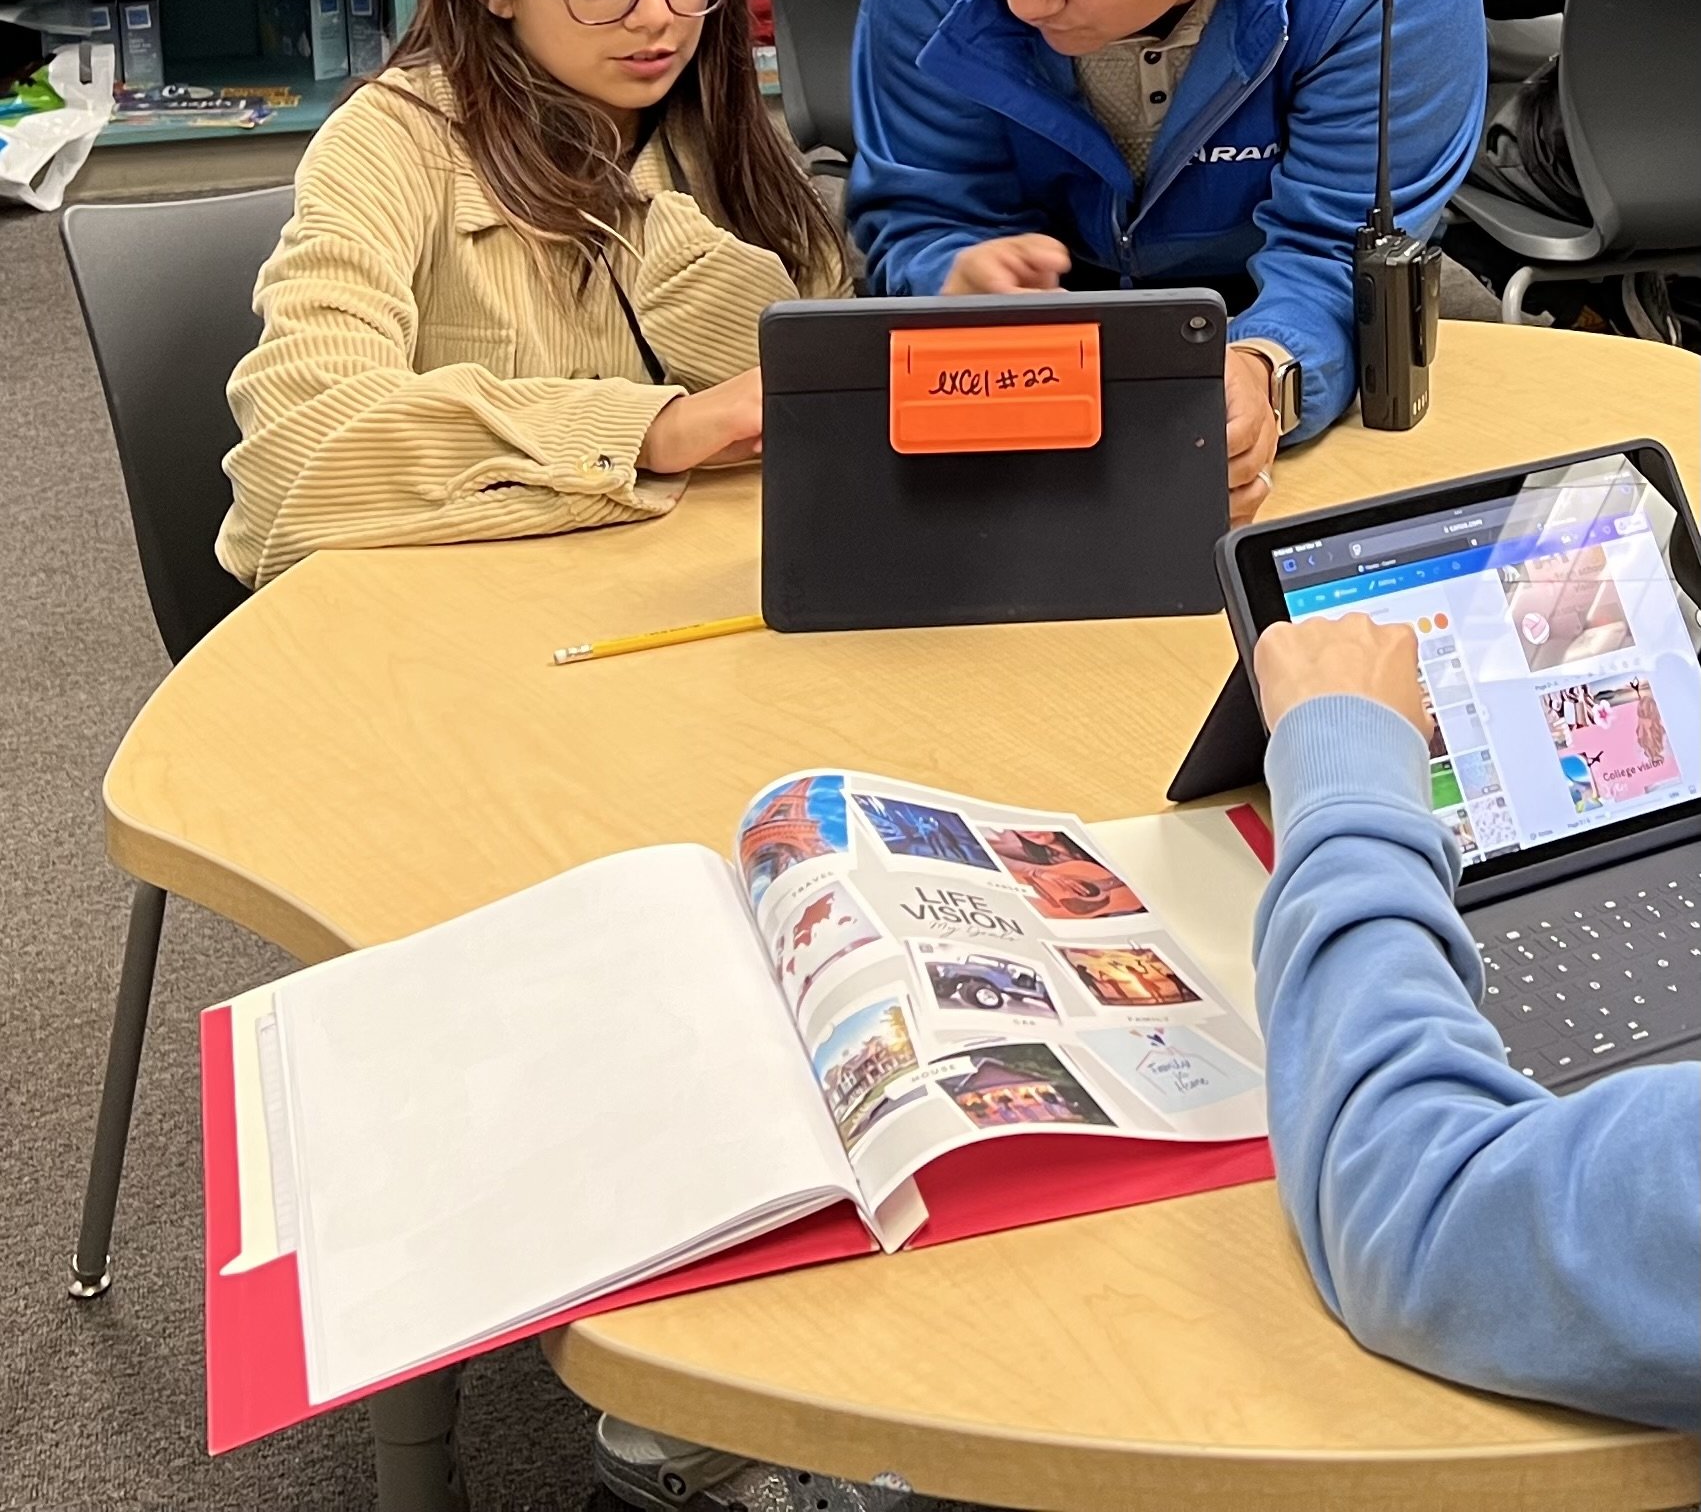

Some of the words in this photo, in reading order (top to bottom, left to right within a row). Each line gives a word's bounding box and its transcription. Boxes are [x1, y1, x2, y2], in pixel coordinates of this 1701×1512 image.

[1602, 766, 1637, 782] College
[1637, 759, 1665, 773] vision
[914, 886, 993, 914] LIFE
[899, 903, 1025, 936] VISION
